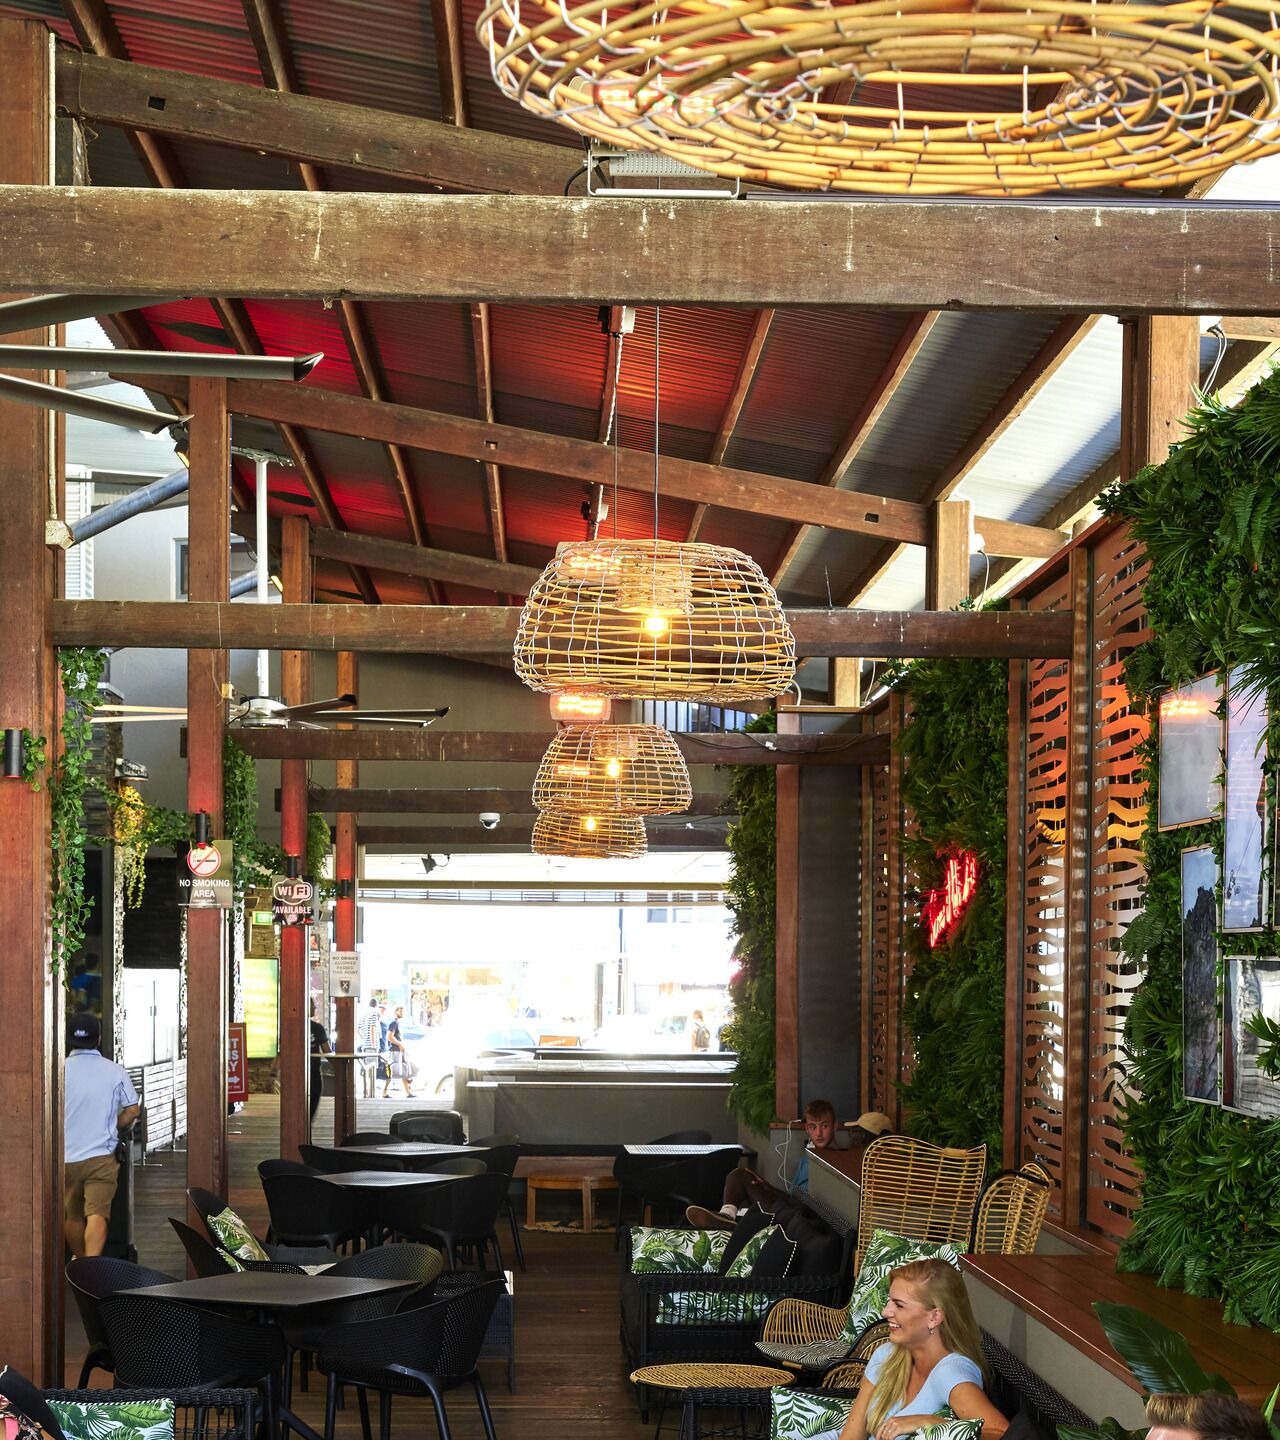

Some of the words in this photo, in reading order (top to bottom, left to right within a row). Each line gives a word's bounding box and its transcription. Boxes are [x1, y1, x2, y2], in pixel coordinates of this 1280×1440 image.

[179, 879, 191, 887] NO
[192, 879, 230, 887] SMOKING
[193, 889, 215, 897] AREA
[275, 906, 312, 914] AVAILABLE
